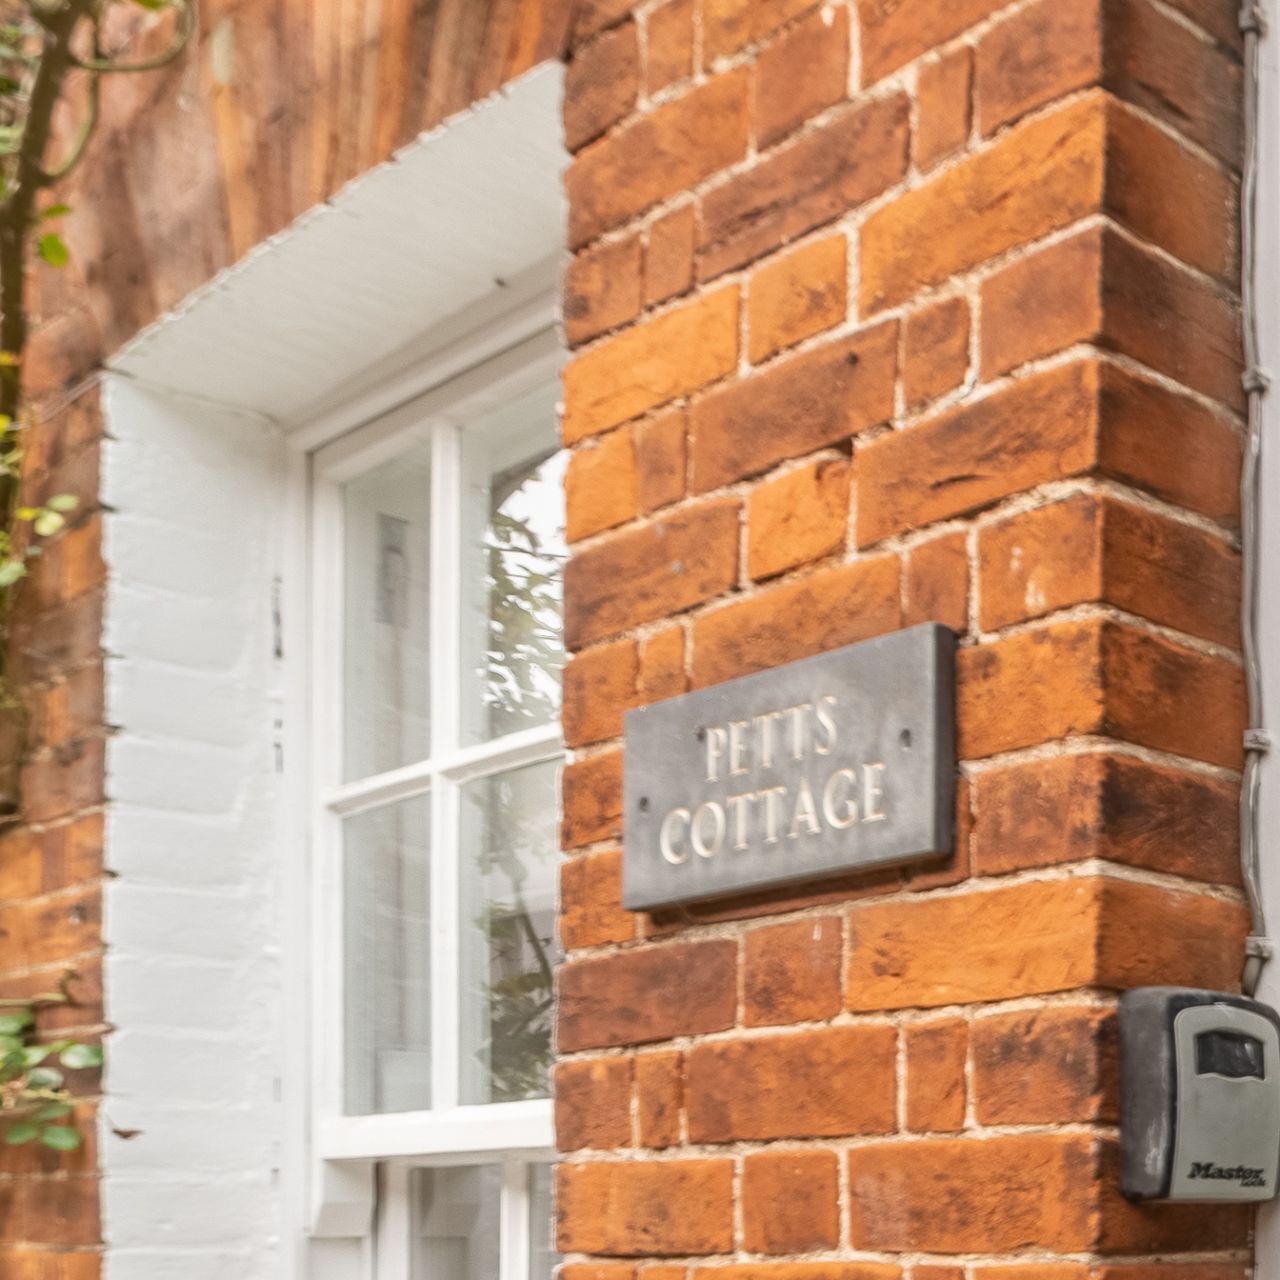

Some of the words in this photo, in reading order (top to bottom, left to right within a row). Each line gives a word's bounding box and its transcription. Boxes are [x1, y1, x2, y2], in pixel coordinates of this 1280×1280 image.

[704, 696, 838, 782] PETTS
[659, 762, 887, 865] COTTAGE
[1187, 1161, 1264, 1180] Master
